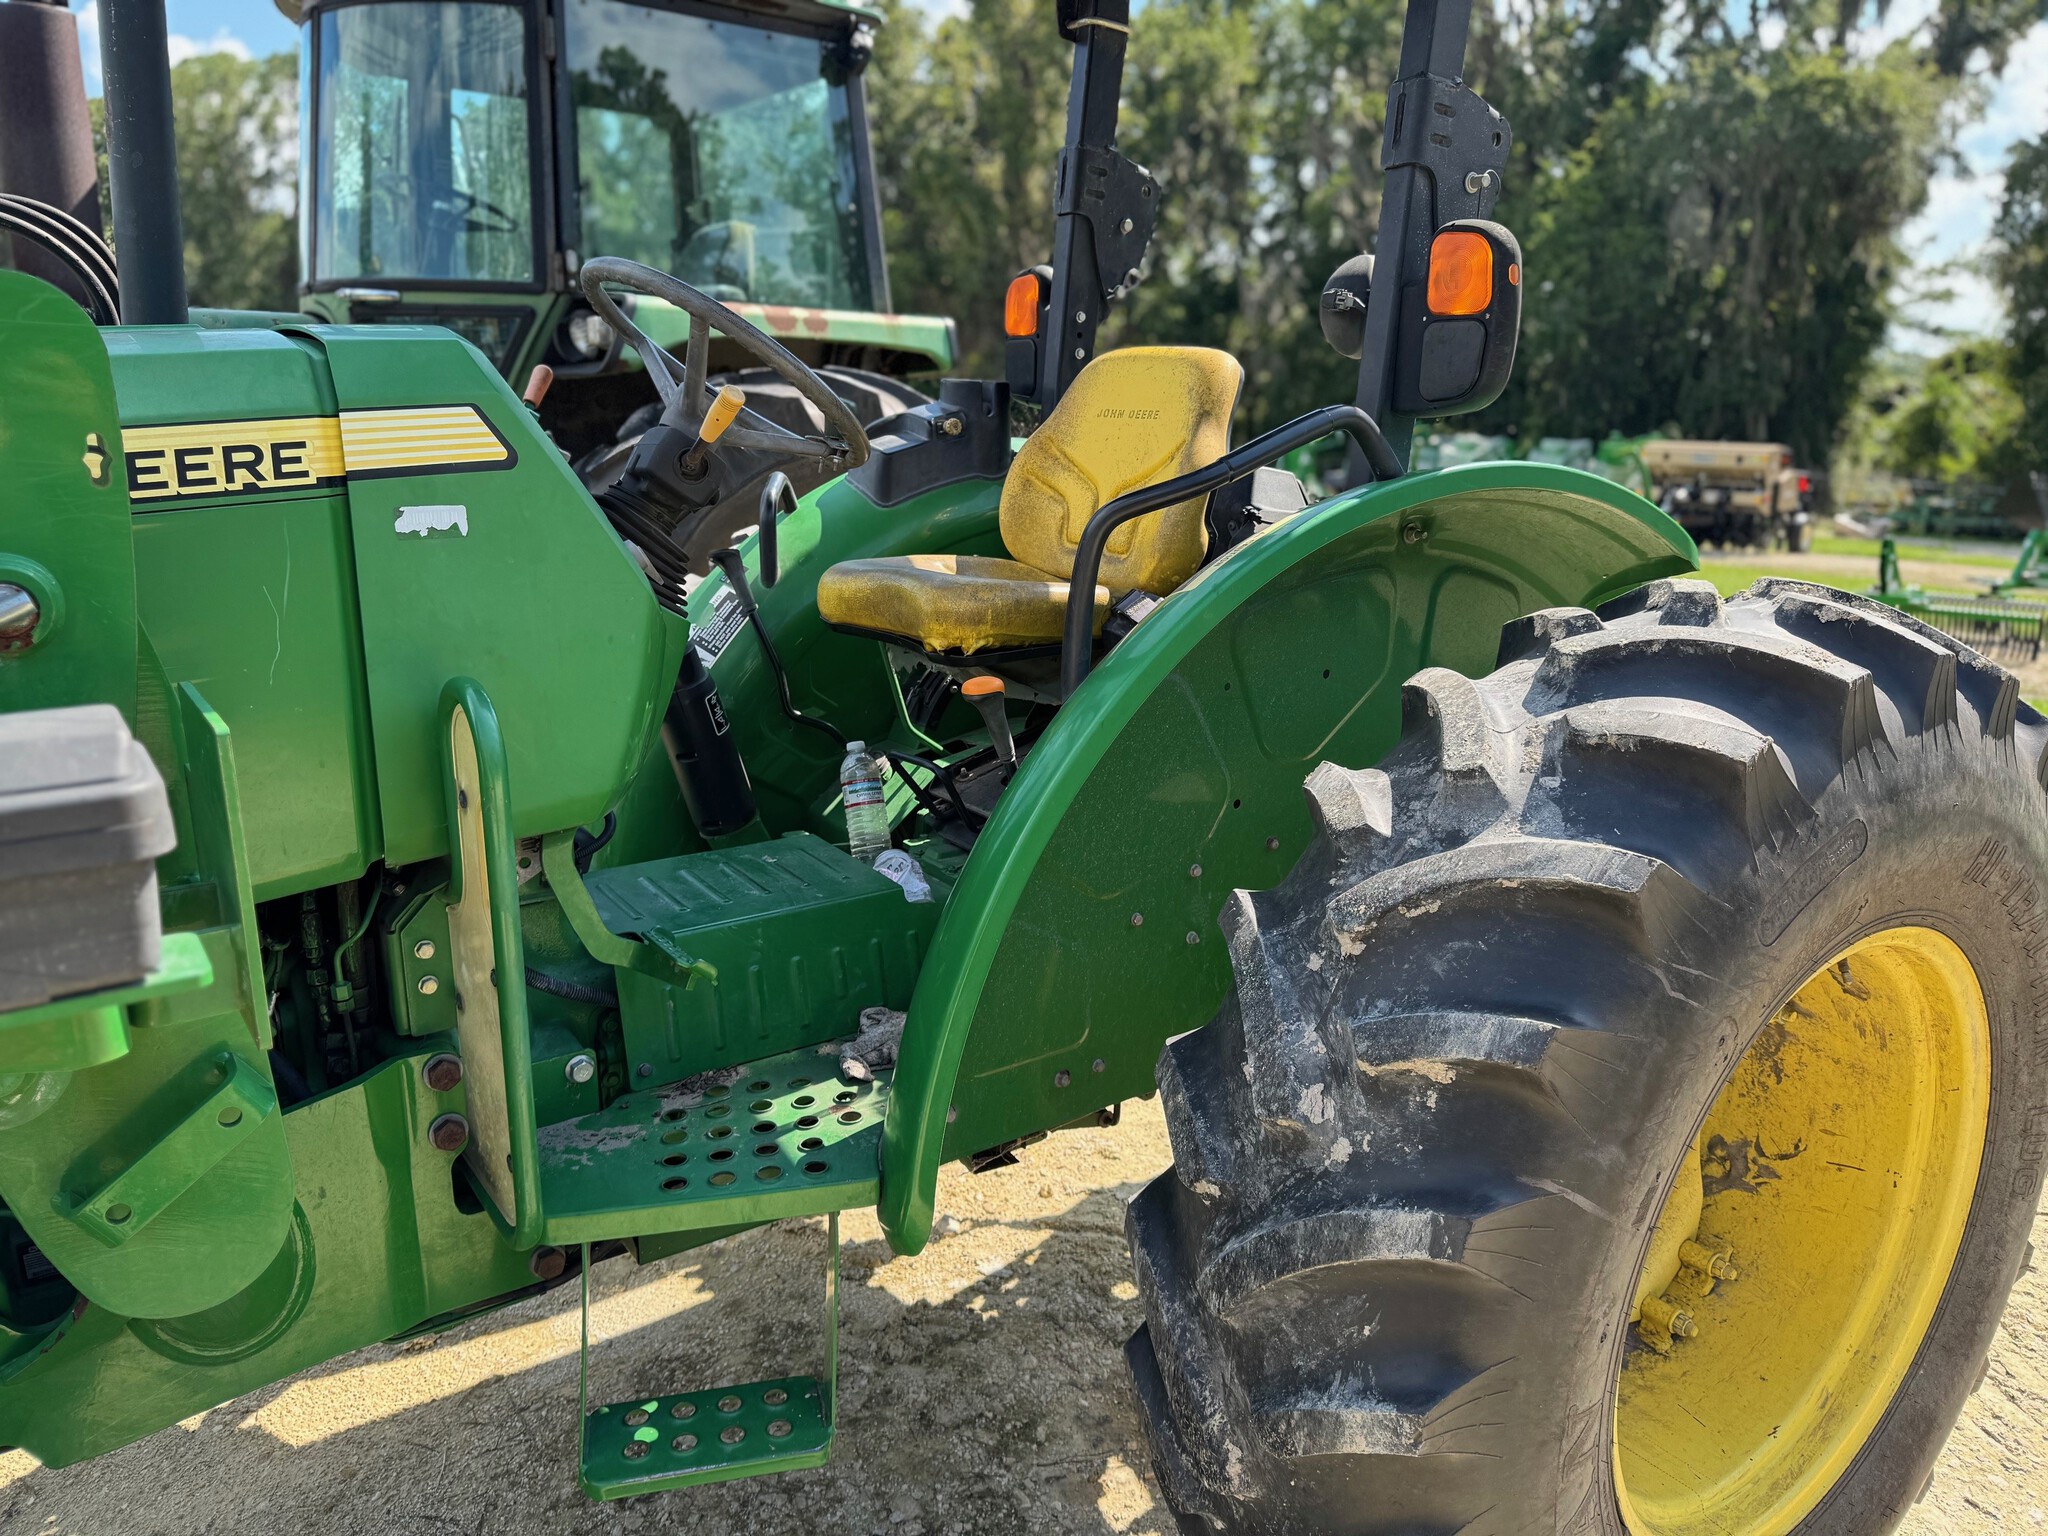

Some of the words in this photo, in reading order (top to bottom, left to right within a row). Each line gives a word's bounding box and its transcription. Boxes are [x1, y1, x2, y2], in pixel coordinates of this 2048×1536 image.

[1097, 408, 1125, 419] JOHN
[1128, 409, 1160, 420] DEERE
[124, 440, 313, 493] EERE
[2012, 1106, 2048, 1197] LUG
